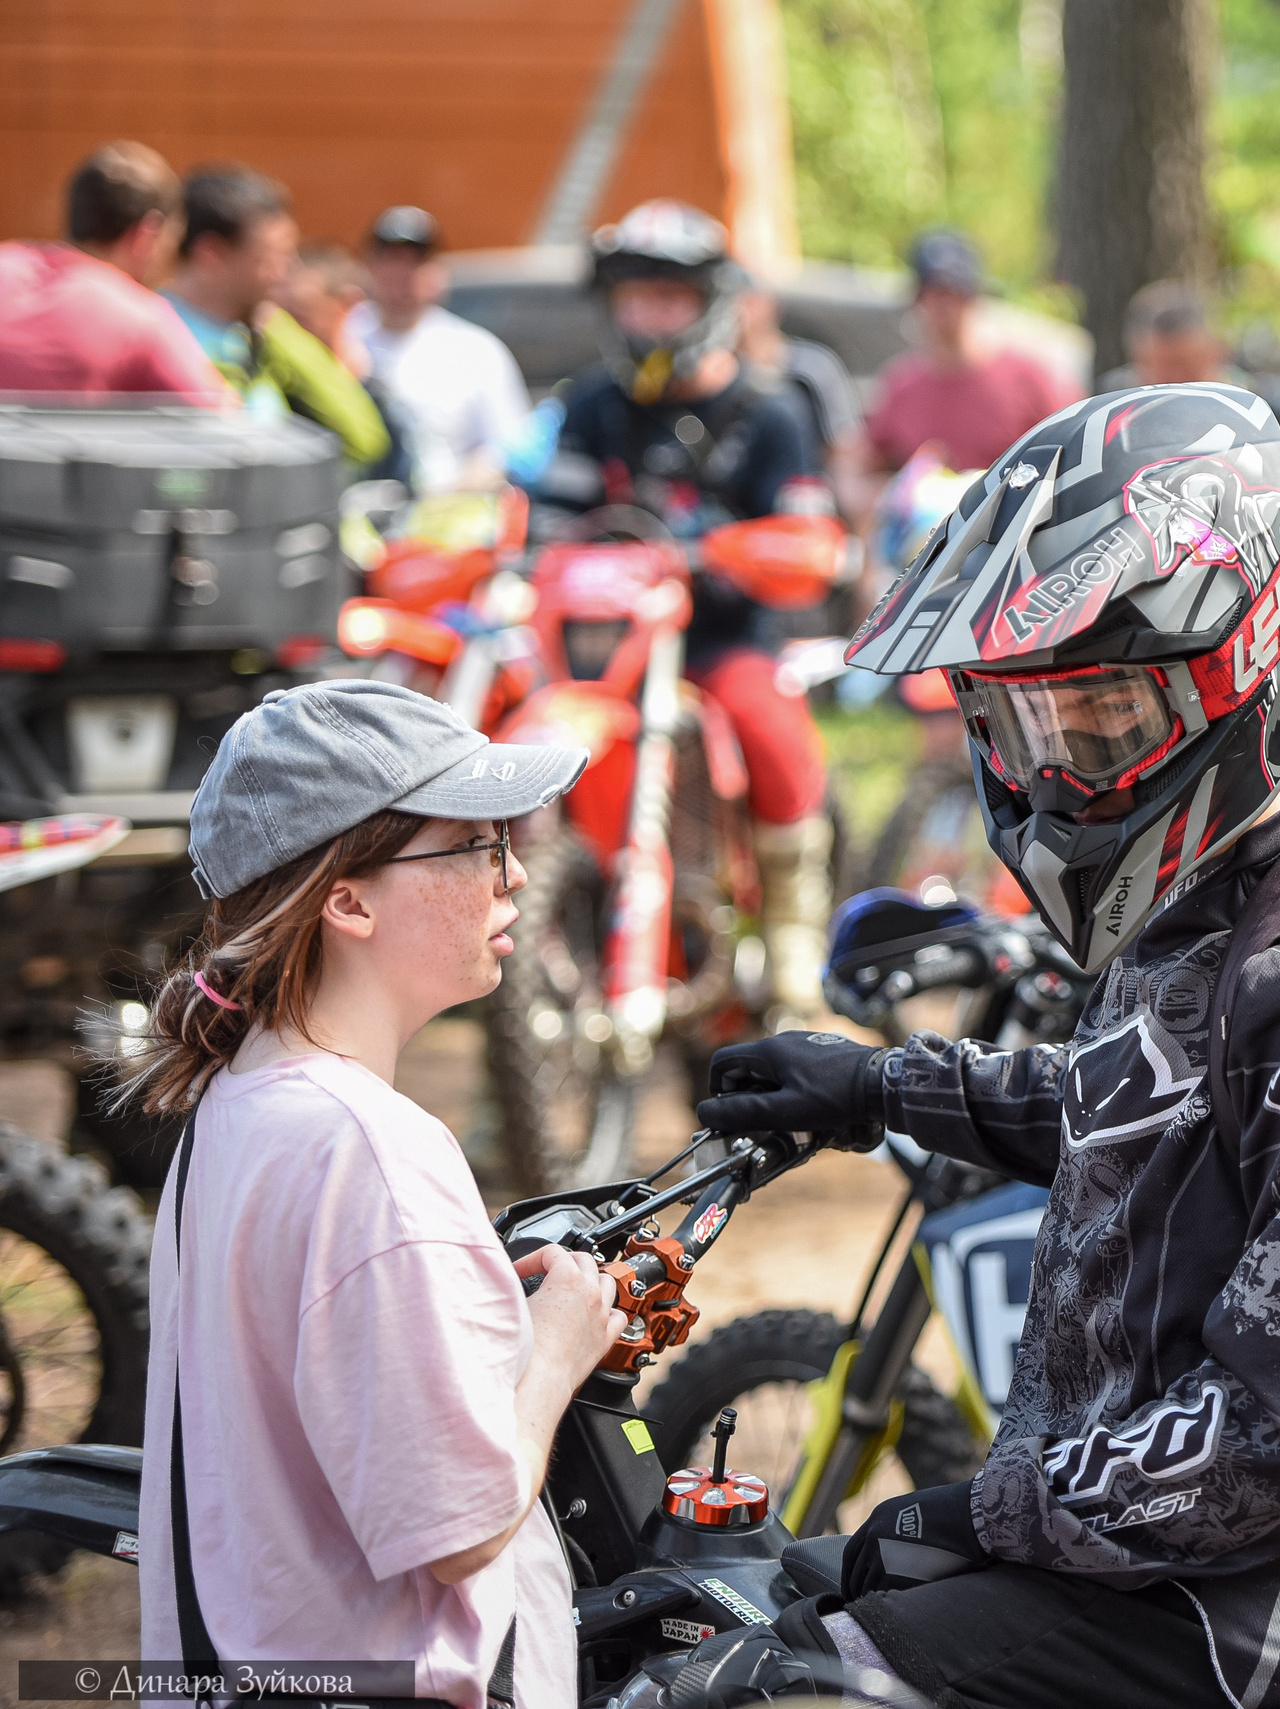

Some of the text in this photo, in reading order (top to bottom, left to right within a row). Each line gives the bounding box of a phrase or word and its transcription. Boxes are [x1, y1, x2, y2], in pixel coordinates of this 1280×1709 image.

[1002, 526, 1146, 644] AIROH
[1105, 875, 1134, 937] AIROH
[1163, 870, 1199, 910] UFO
[699, 1582, 757, 1627] MOTOCRO
[662, 1619, 700, 1634] MADE IN
[663, 1626, 699, 1642] JAPAN
